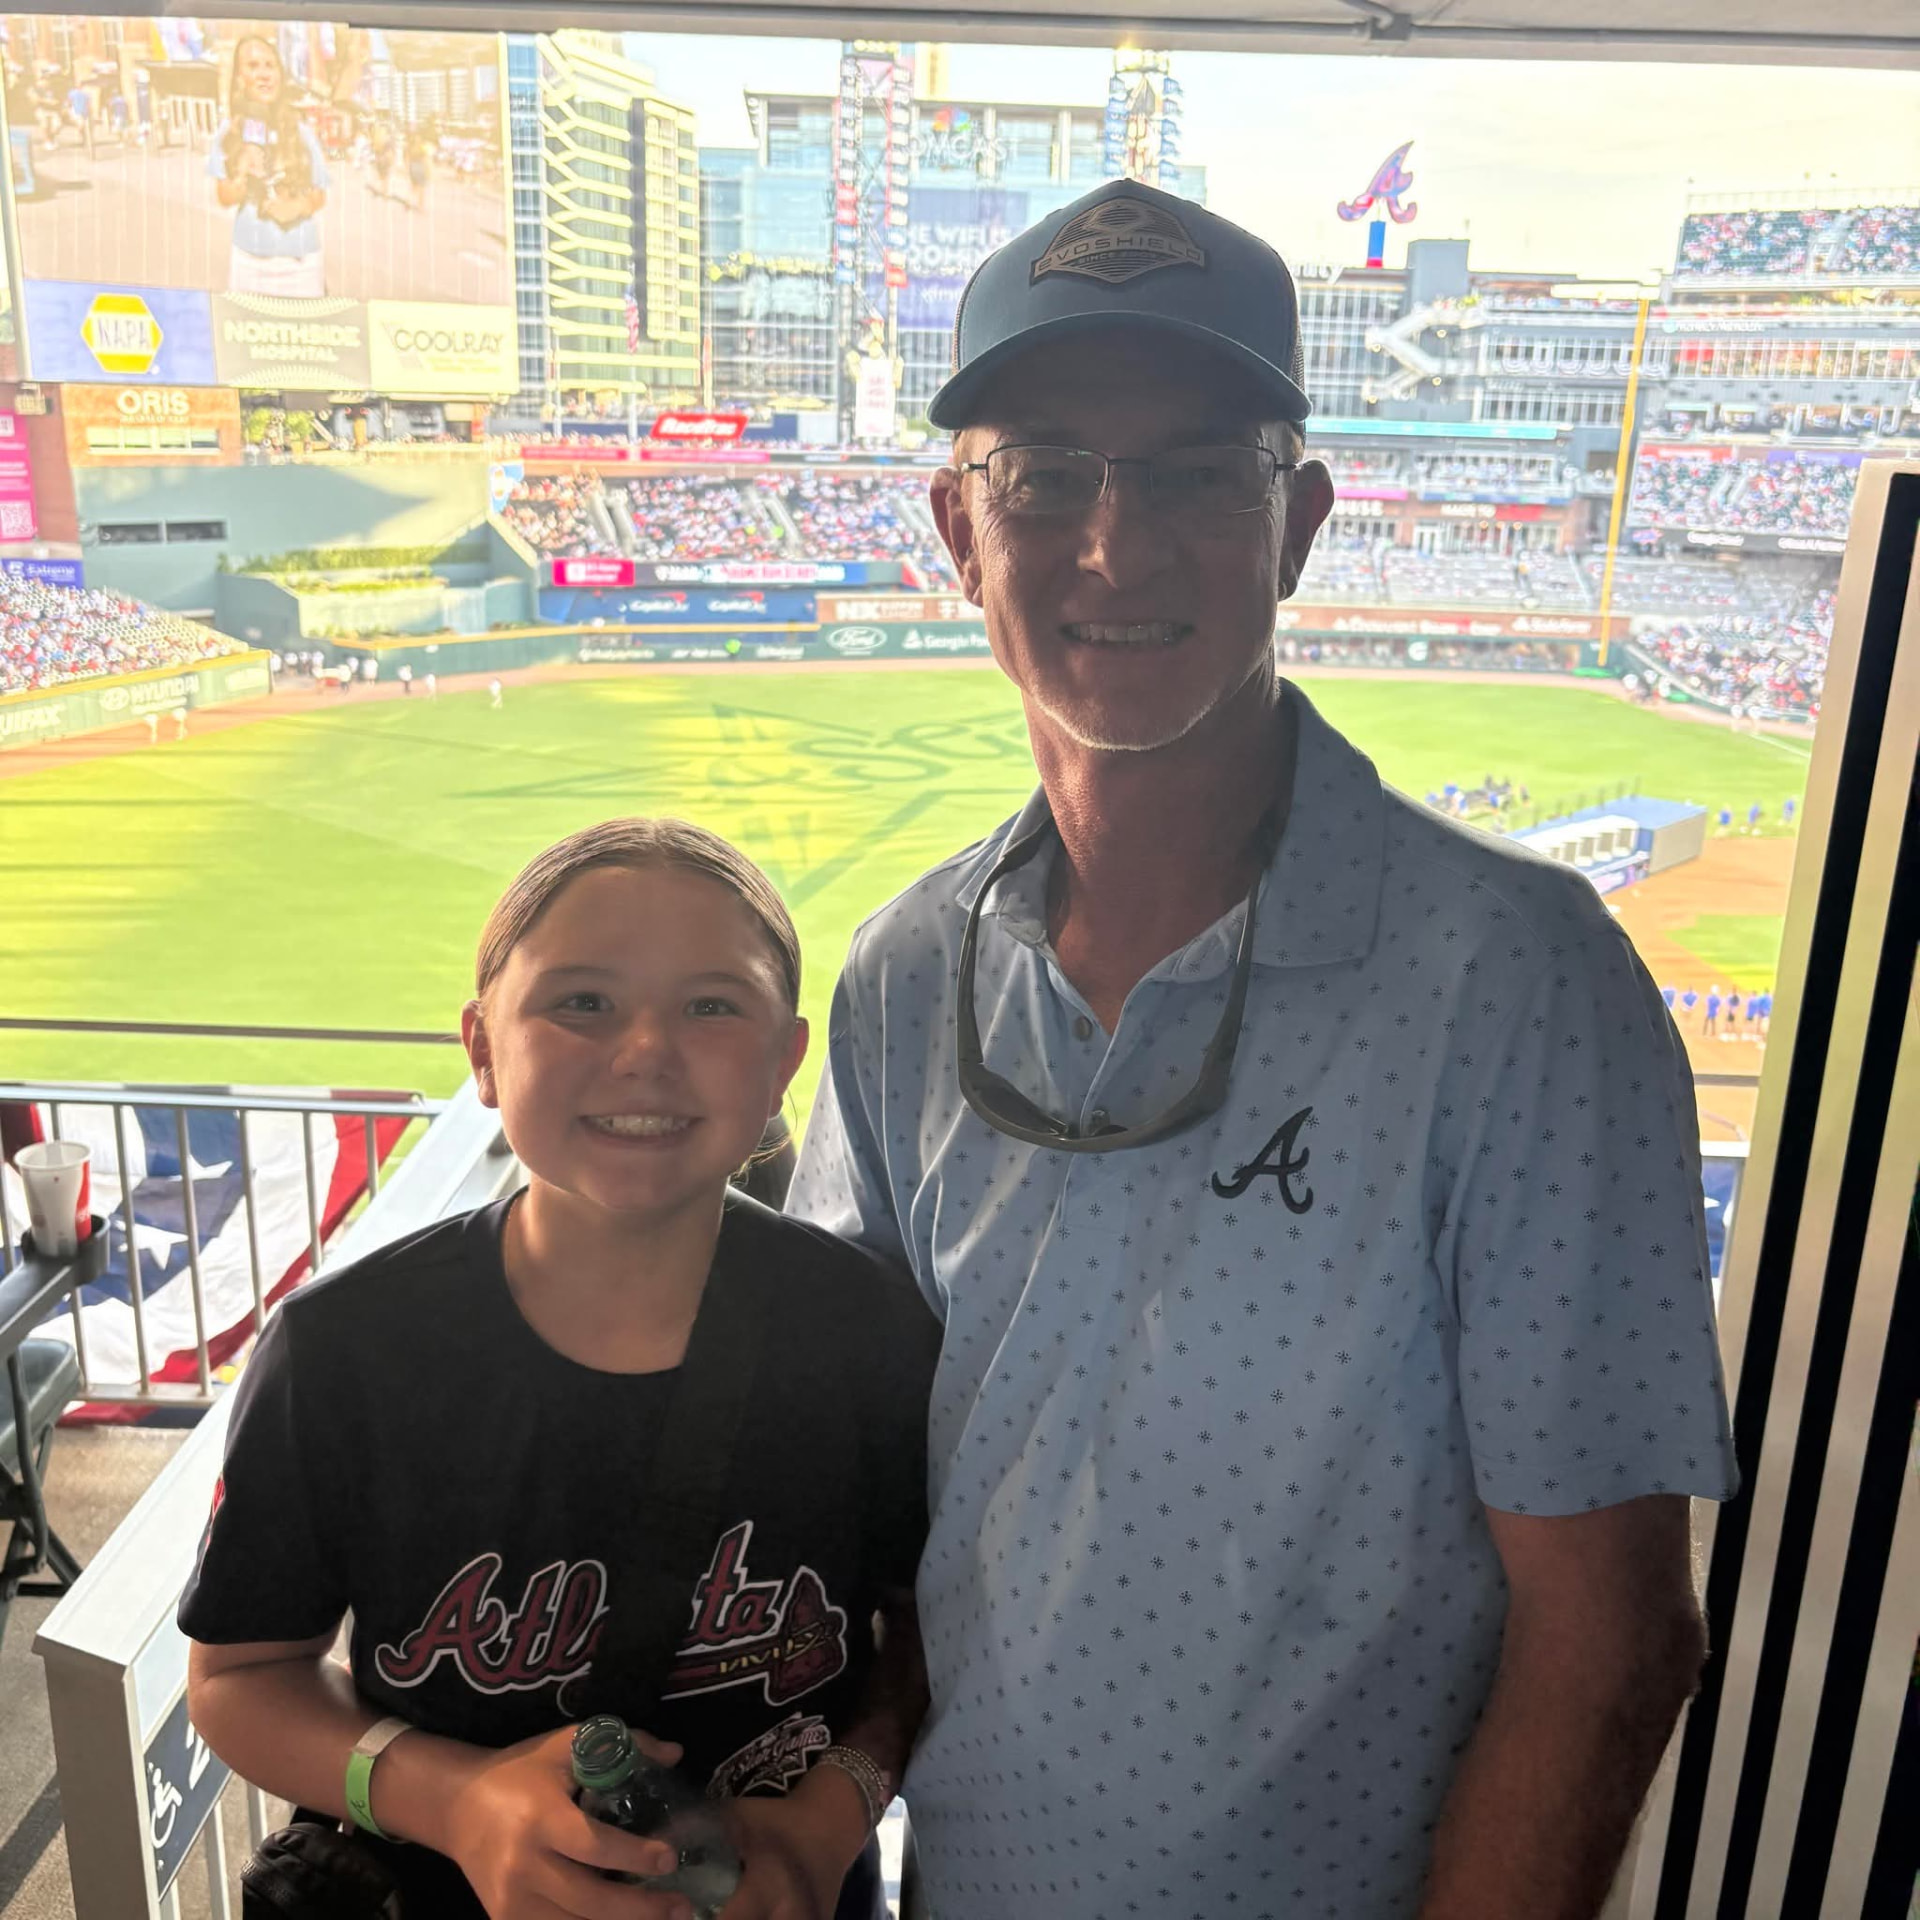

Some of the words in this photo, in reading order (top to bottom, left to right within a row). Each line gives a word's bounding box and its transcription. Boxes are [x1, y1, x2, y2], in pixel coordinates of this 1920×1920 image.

[905, 134, 1019, 161] OMCAST
[96, 318, 149, 350] NAPA
[223, 320, 361, 348] NORTHSIDE
[393, 329, 505, 354] COOLRAY
[249, 344, 339, 363] HOSPITAL
[116, 389, 190, 415] ORIS
[839, 629, 876, 647] Ford
[131, 674, 200, 700] HYUNDAI
[1212, 1106, 1314, 1215] A
